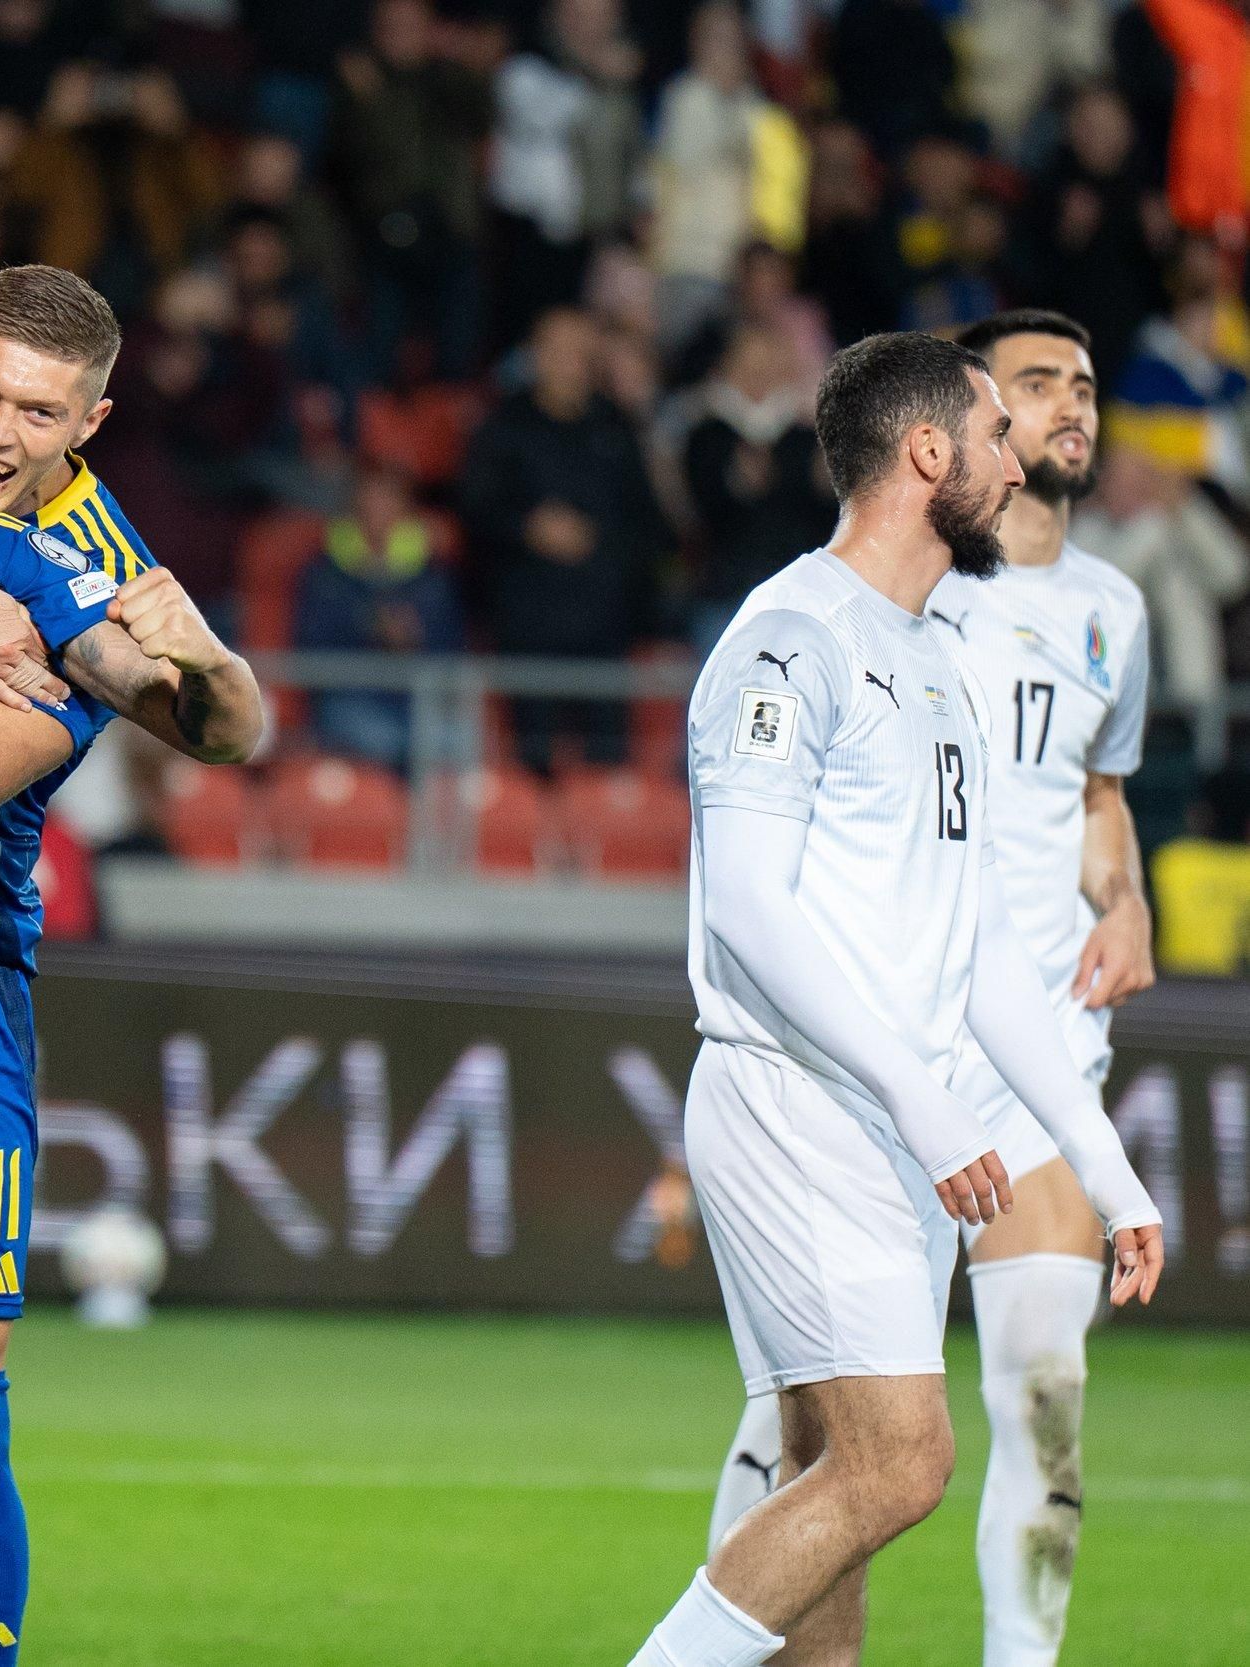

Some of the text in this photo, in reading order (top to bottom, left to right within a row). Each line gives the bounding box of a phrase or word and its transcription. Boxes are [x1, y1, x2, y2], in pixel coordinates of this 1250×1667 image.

[1013, 680, 1054, 765] 17
[935, 741, 967, 841] 13
[30, 1033, 515, 1258] ЬКИ
